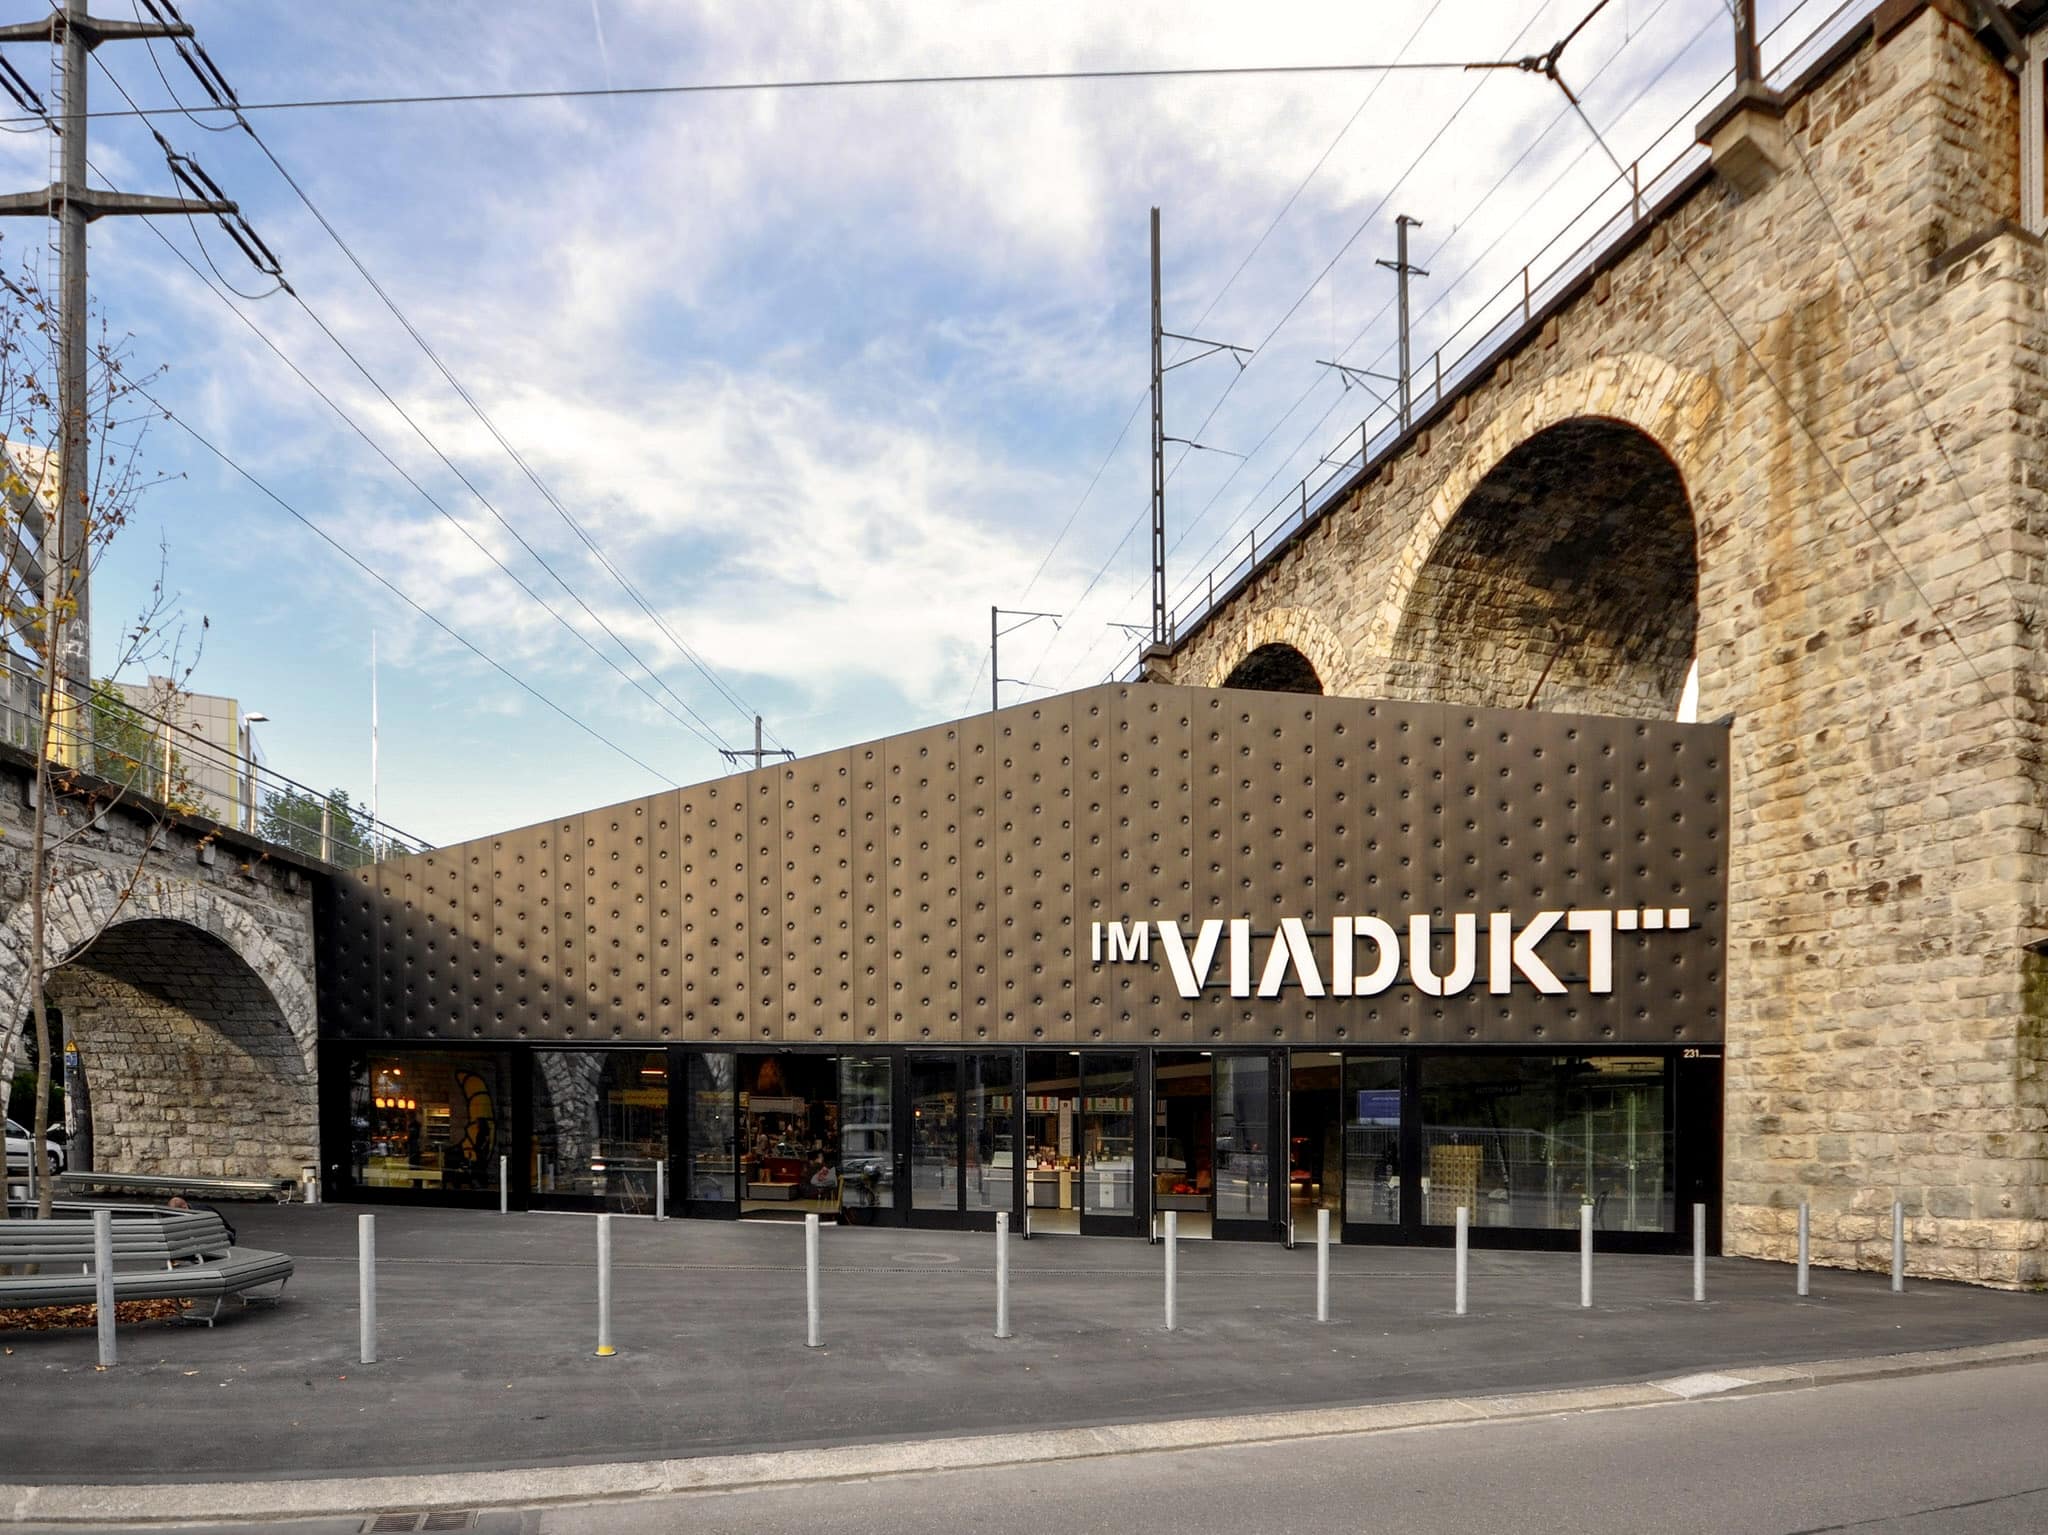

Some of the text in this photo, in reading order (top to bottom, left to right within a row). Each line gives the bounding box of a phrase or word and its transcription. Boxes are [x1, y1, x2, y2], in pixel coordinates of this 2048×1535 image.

[1091, 909, 1613, 998] IM VIADUKT
[1683, 1048, 1700, 1058] 231
